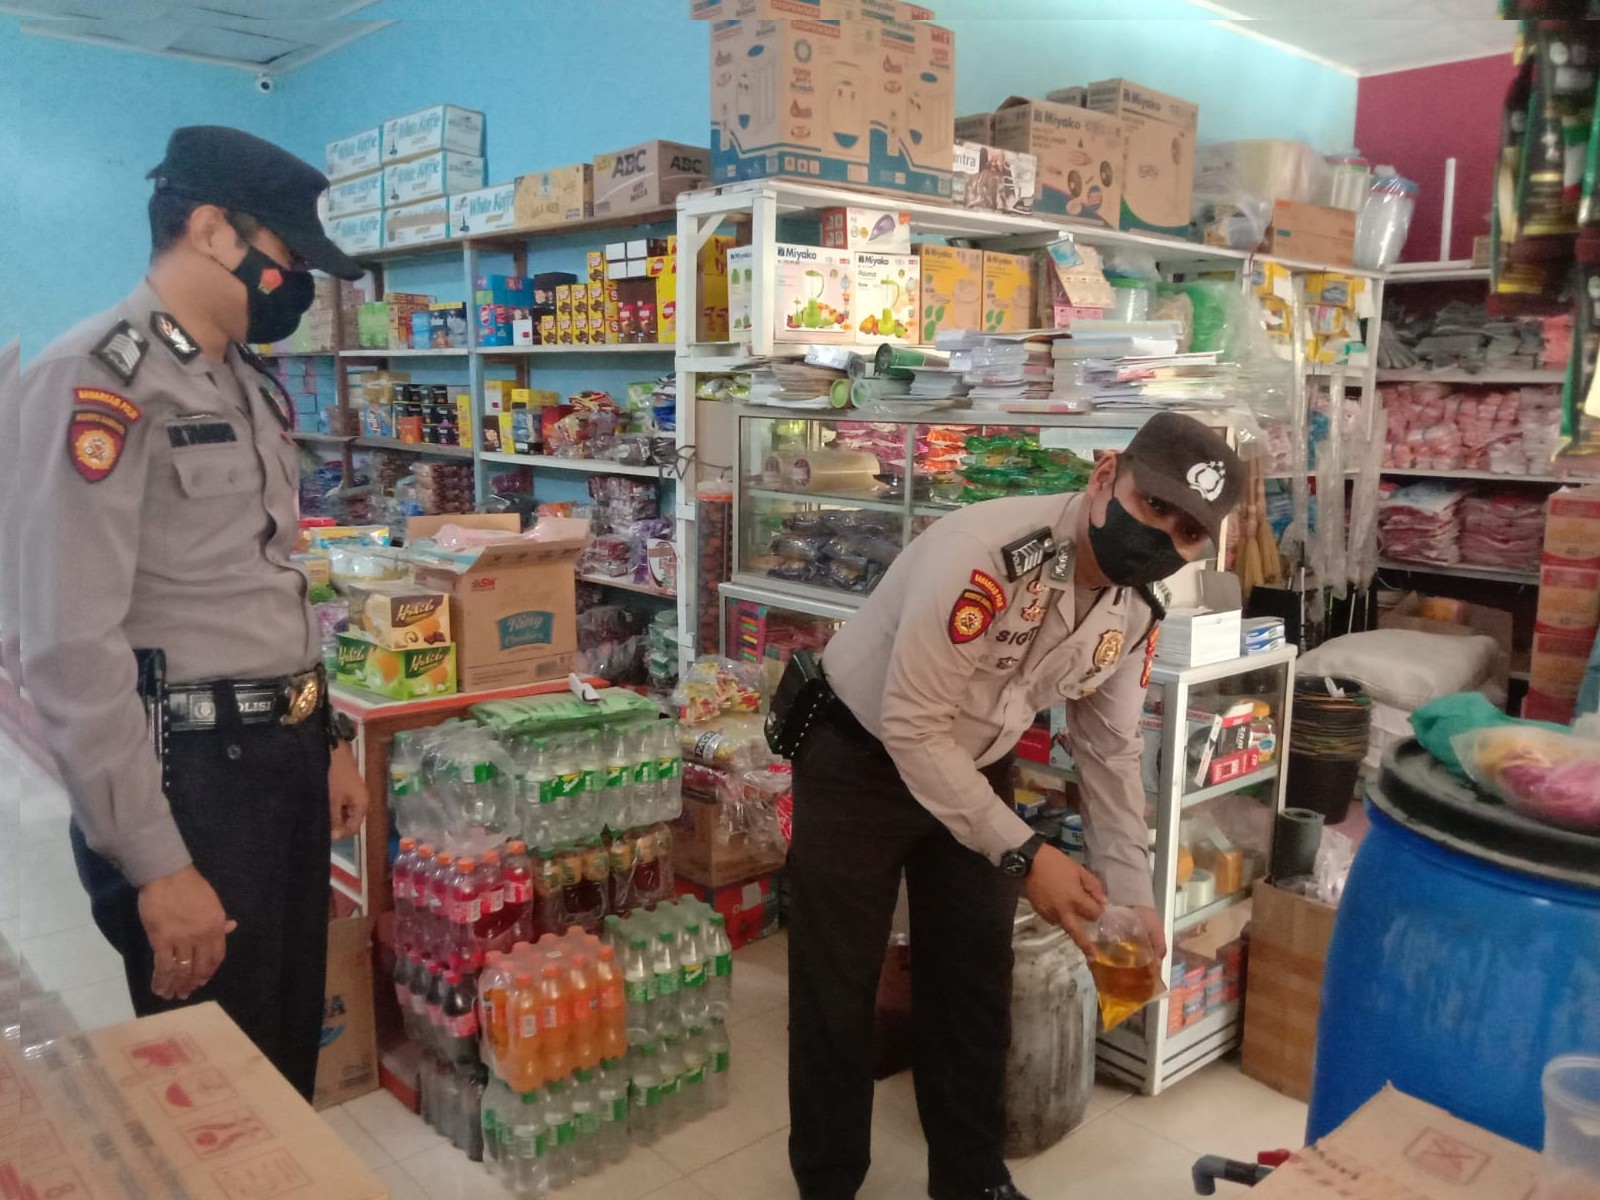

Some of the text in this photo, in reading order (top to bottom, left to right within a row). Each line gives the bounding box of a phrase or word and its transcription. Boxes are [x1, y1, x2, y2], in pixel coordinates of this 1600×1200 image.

[612, 150, 648, 178] ABC
[671, 155, 703, 173] ABC
[785, 248, 817, 261] Miyako
[865, 255, 889, 267] Miyako
